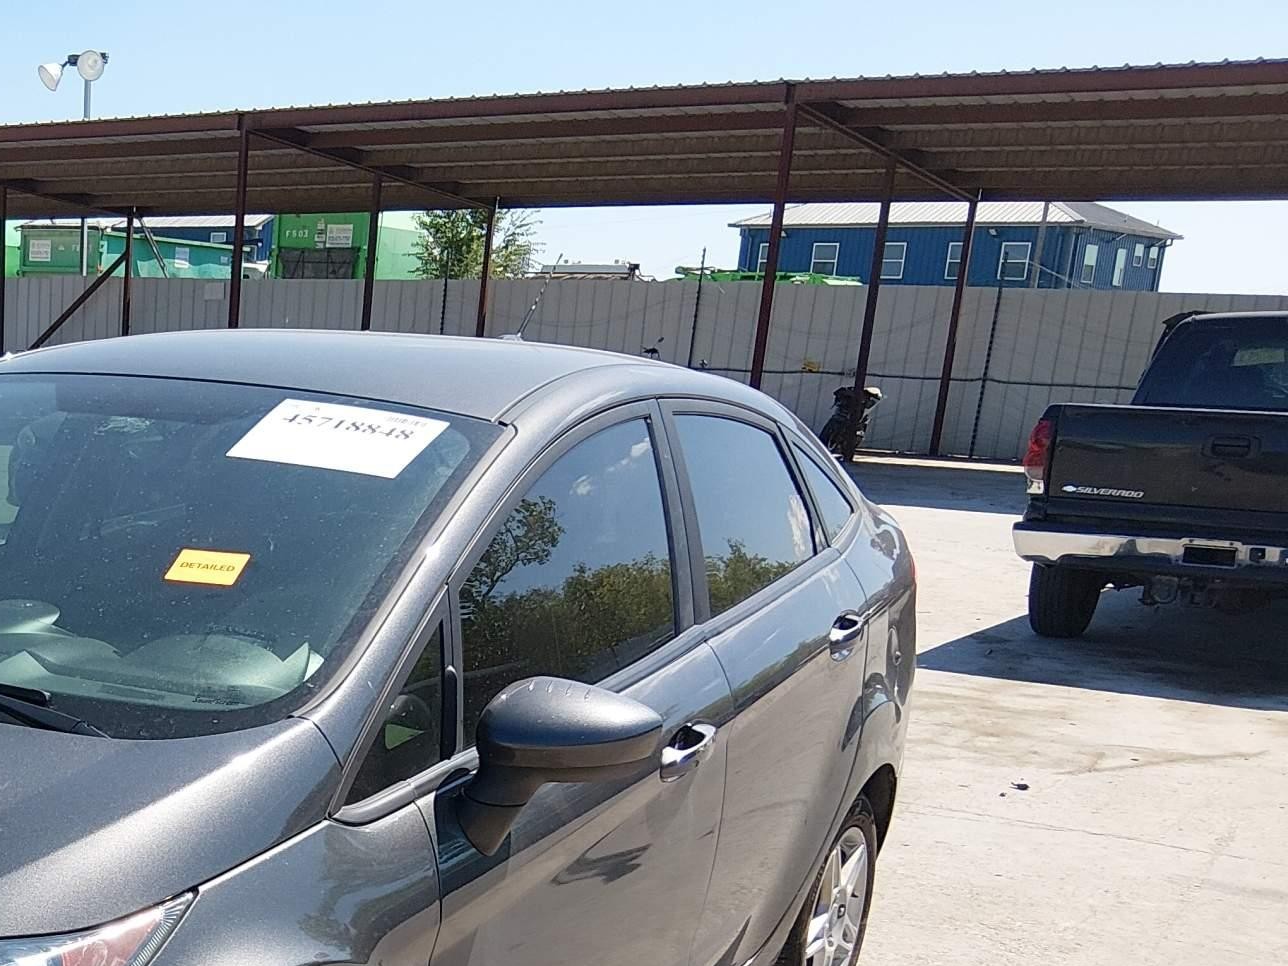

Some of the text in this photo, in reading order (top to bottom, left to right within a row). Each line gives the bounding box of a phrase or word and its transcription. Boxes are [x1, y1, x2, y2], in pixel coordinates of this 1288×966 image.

[281, 412, 416, 441] 45718848
[1075, 486, 1145, 499] SILVERADO
[179, 561, 236, 572] DETAILED
